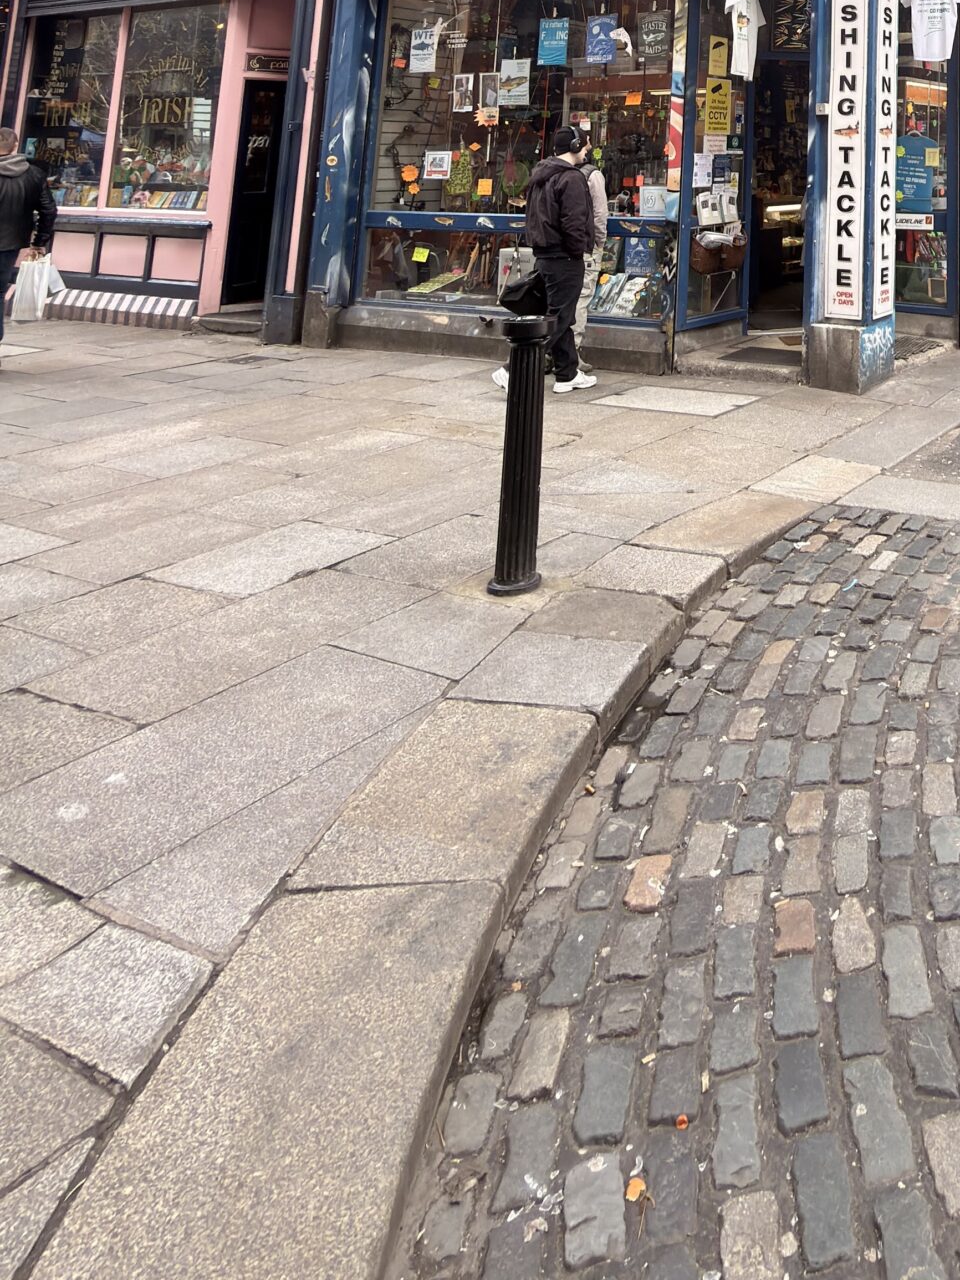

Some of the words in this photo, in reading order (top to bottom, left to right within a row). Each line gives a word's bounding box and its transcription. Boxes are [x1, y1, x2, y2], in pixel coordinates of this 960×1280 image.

[642, 21, 667, 32] MASTER
[414, 31, 434, 40] WTF
[645, 45, 662, 54] BAITS
[142, 96, 194, 124] IRISH
[708, 111, 727, 120] CCTV
[836, 146, 855, 287] TACKLE
[880, 146, 890, 286] TACKLE
[836, 291, 853, 299] OPEN
[838, 298, 854, 306] DAYS
